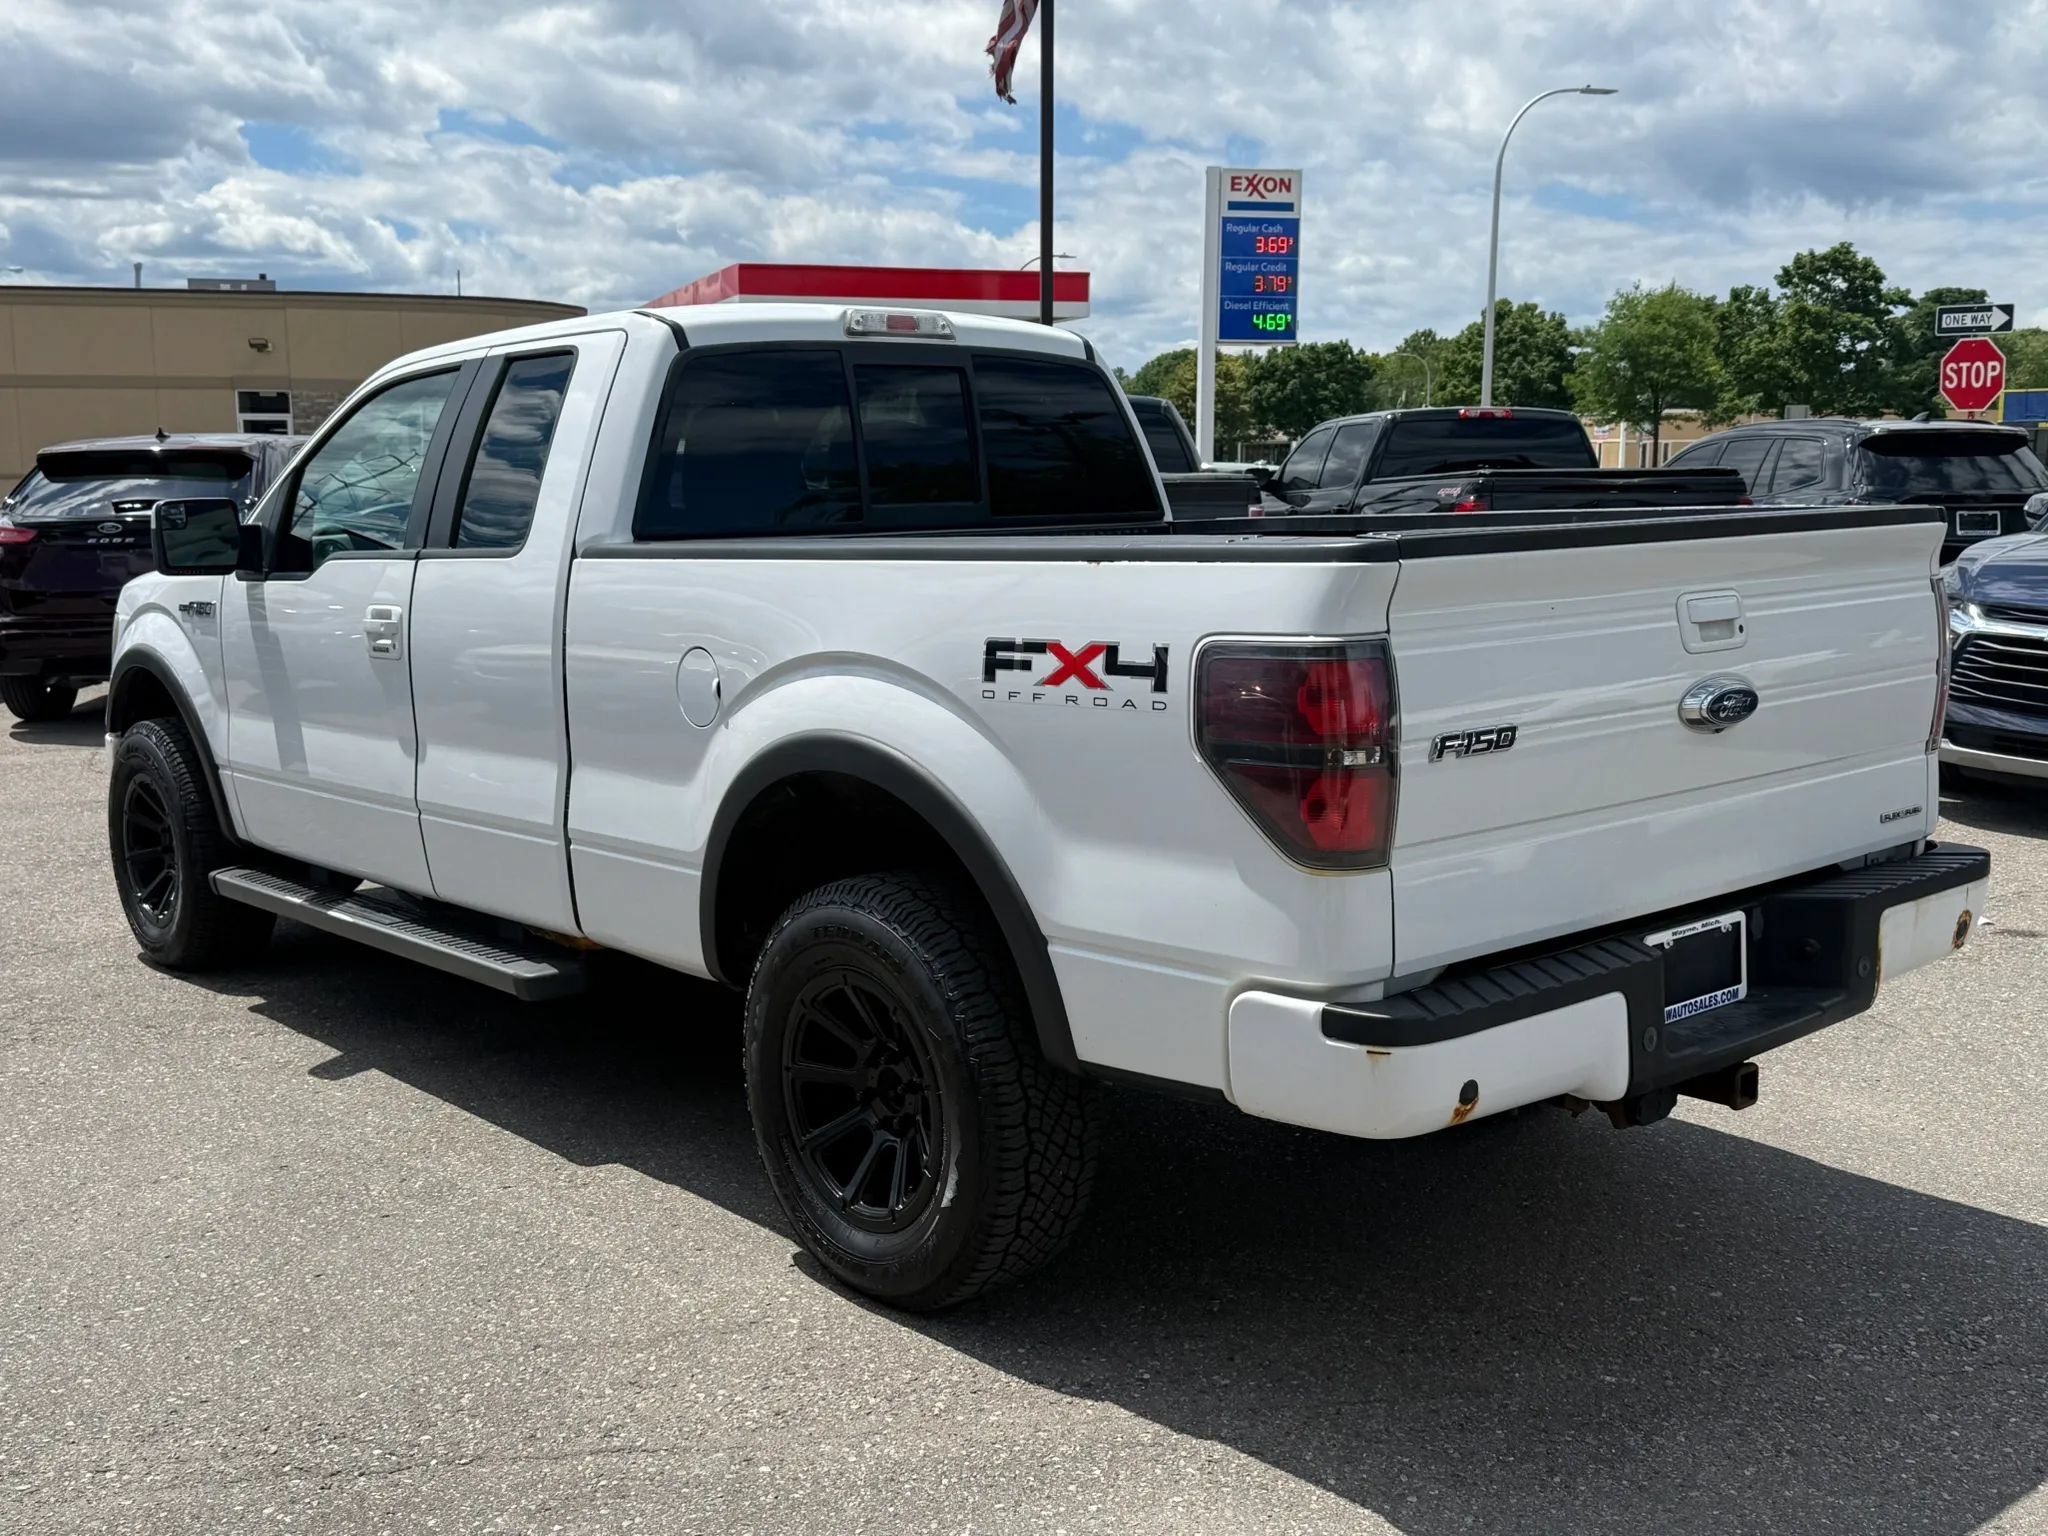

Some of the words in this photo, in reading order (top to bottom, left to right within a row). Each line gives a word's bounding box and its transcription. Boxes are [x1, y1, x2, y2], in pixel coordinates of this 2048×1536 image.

[1230, 173, 1292, 199] EXXON
[1226, 223, 1260, 234] Regular
[1261, 223, 1284, 233] Cash
[1225, 262, 1259, 273] Regular
[1261, 262, 1287, 272] Credit
[1224, 300, 1252, 310] Diesel
[1253, 300, 1290, 311] Efficient
[1944, 314, 1968, 326] ONE
[1970, 313, 1993, 325] WAY
[1944, 360, 2001, 389] STOP
[982, 637, 1170, 693] FX4
[1671, 925, 1699, 937] Wayne,
